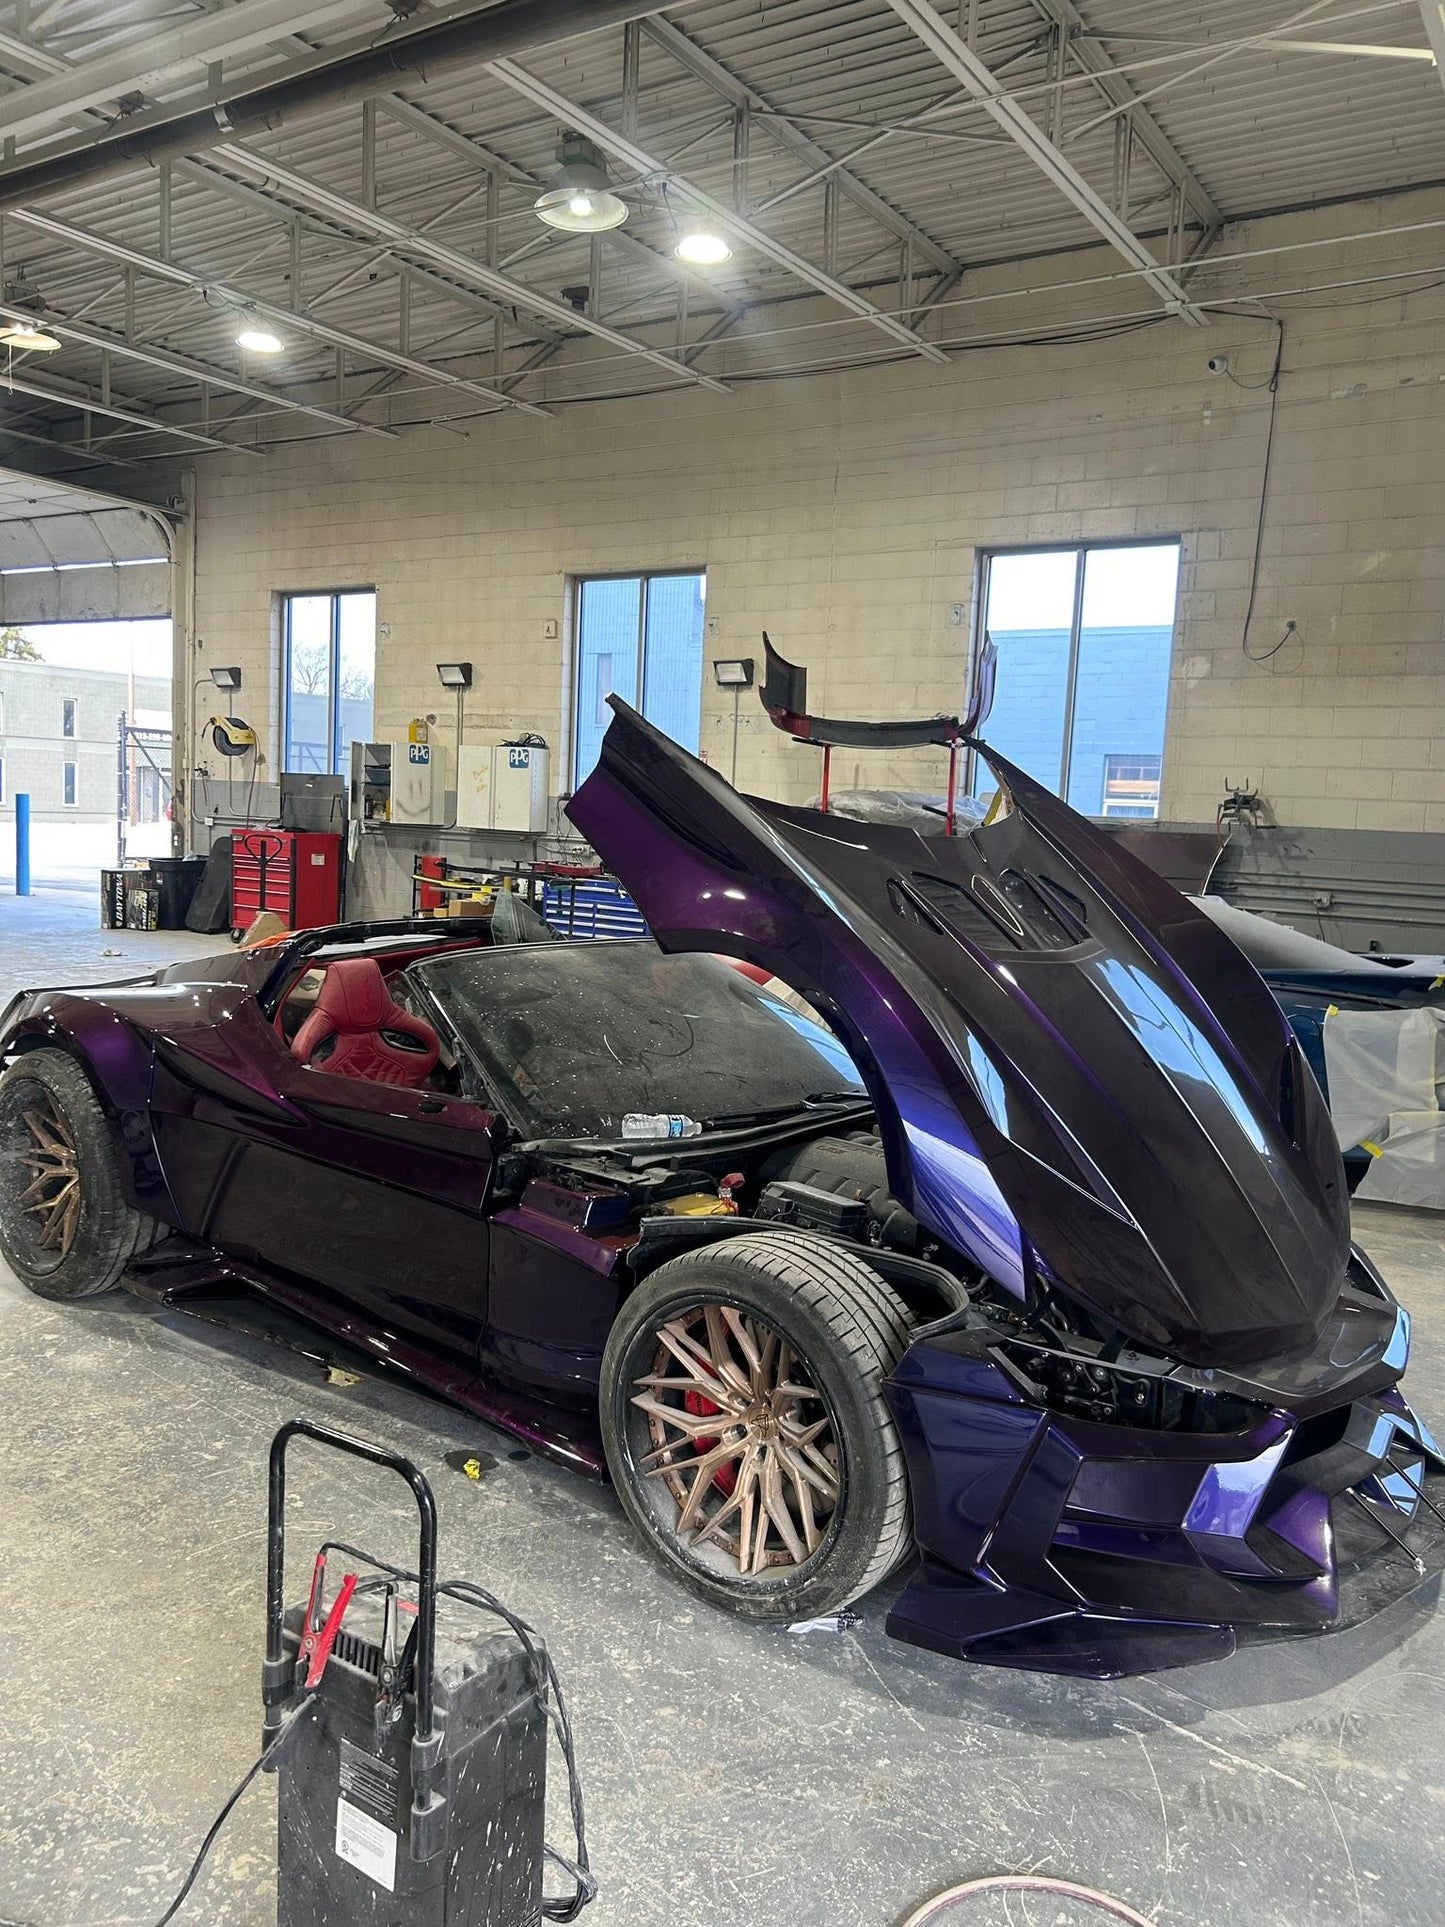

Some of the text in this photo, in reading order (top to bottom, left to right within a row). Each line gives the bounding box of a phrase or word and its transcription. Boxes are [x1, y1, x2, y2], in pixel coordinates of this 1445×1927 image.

[410, 744, 429, 761] PPG
[510, 748, 529, 765] PPG
[115, 873, 123, 921] DAYTONA
